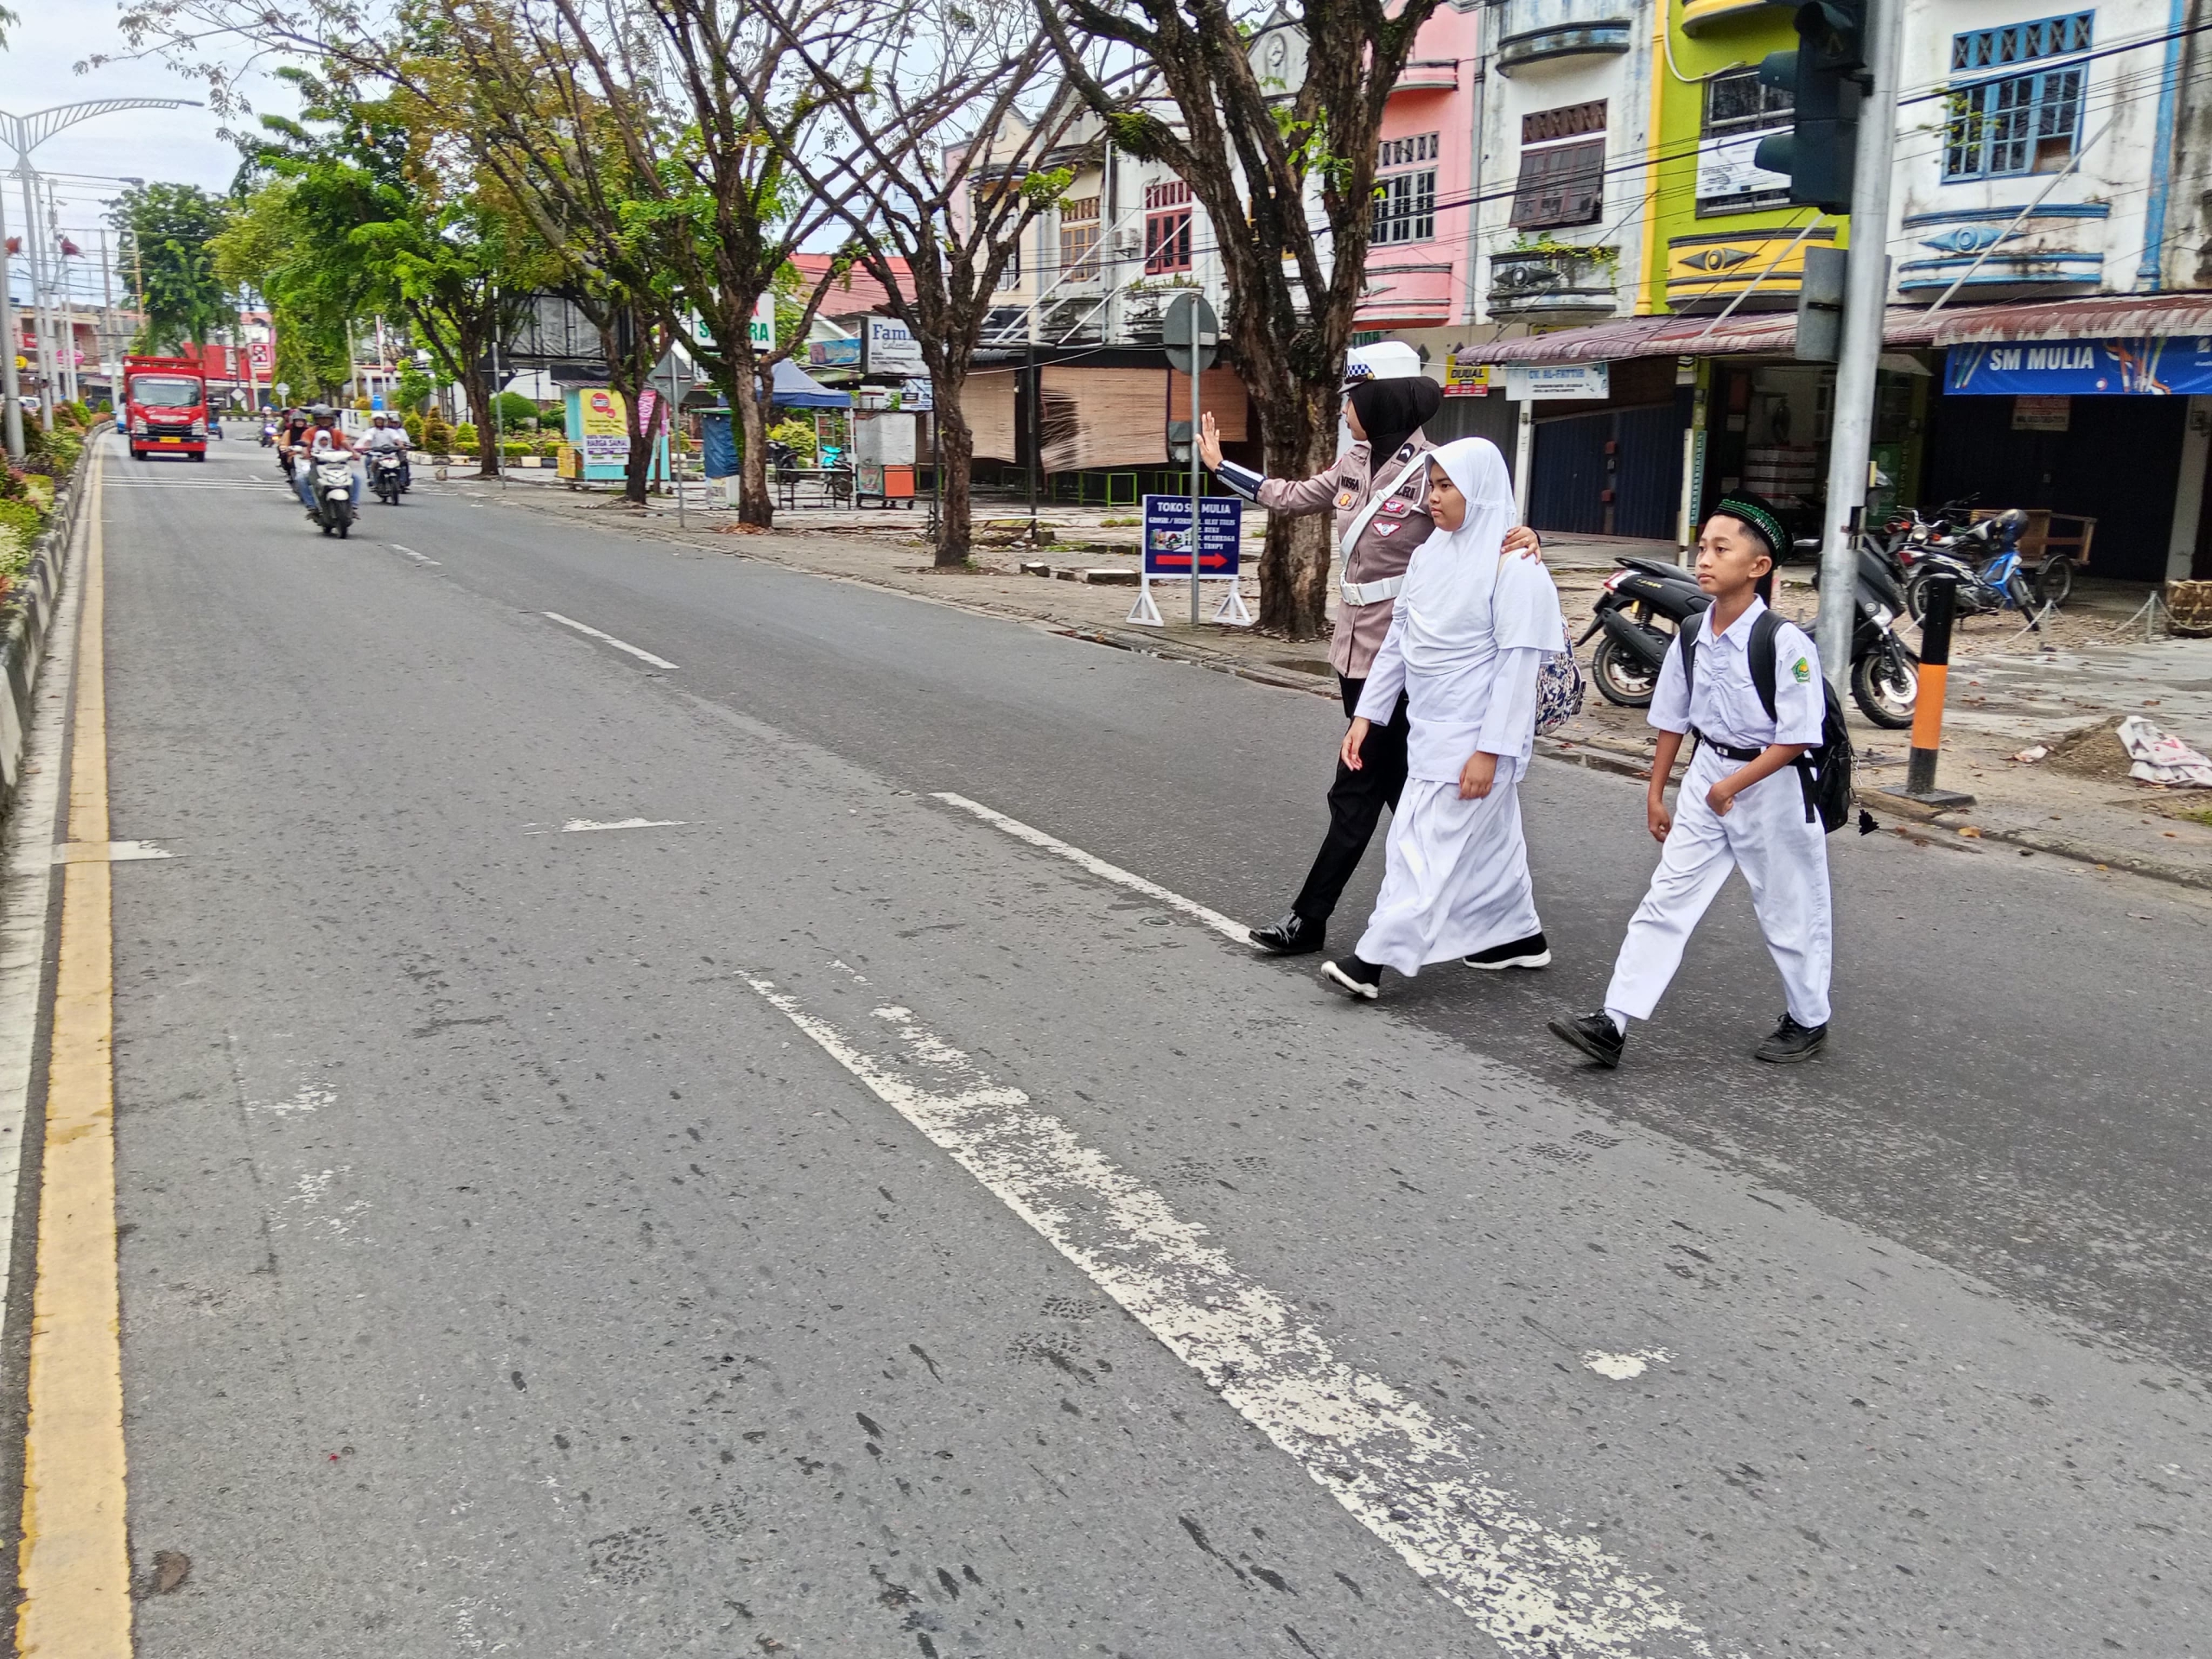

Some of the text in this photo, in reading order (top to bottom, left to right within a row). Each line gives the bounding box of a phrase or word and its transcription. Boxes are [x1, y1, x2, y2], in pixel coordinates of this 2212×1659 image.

[872, 324, 916, 340] Fam
[1989, 346, 2094, 371] SM MULIA
[1157, 502, 1184, 512] TOKO
[1201, 504, 1231, 514] MULIA
